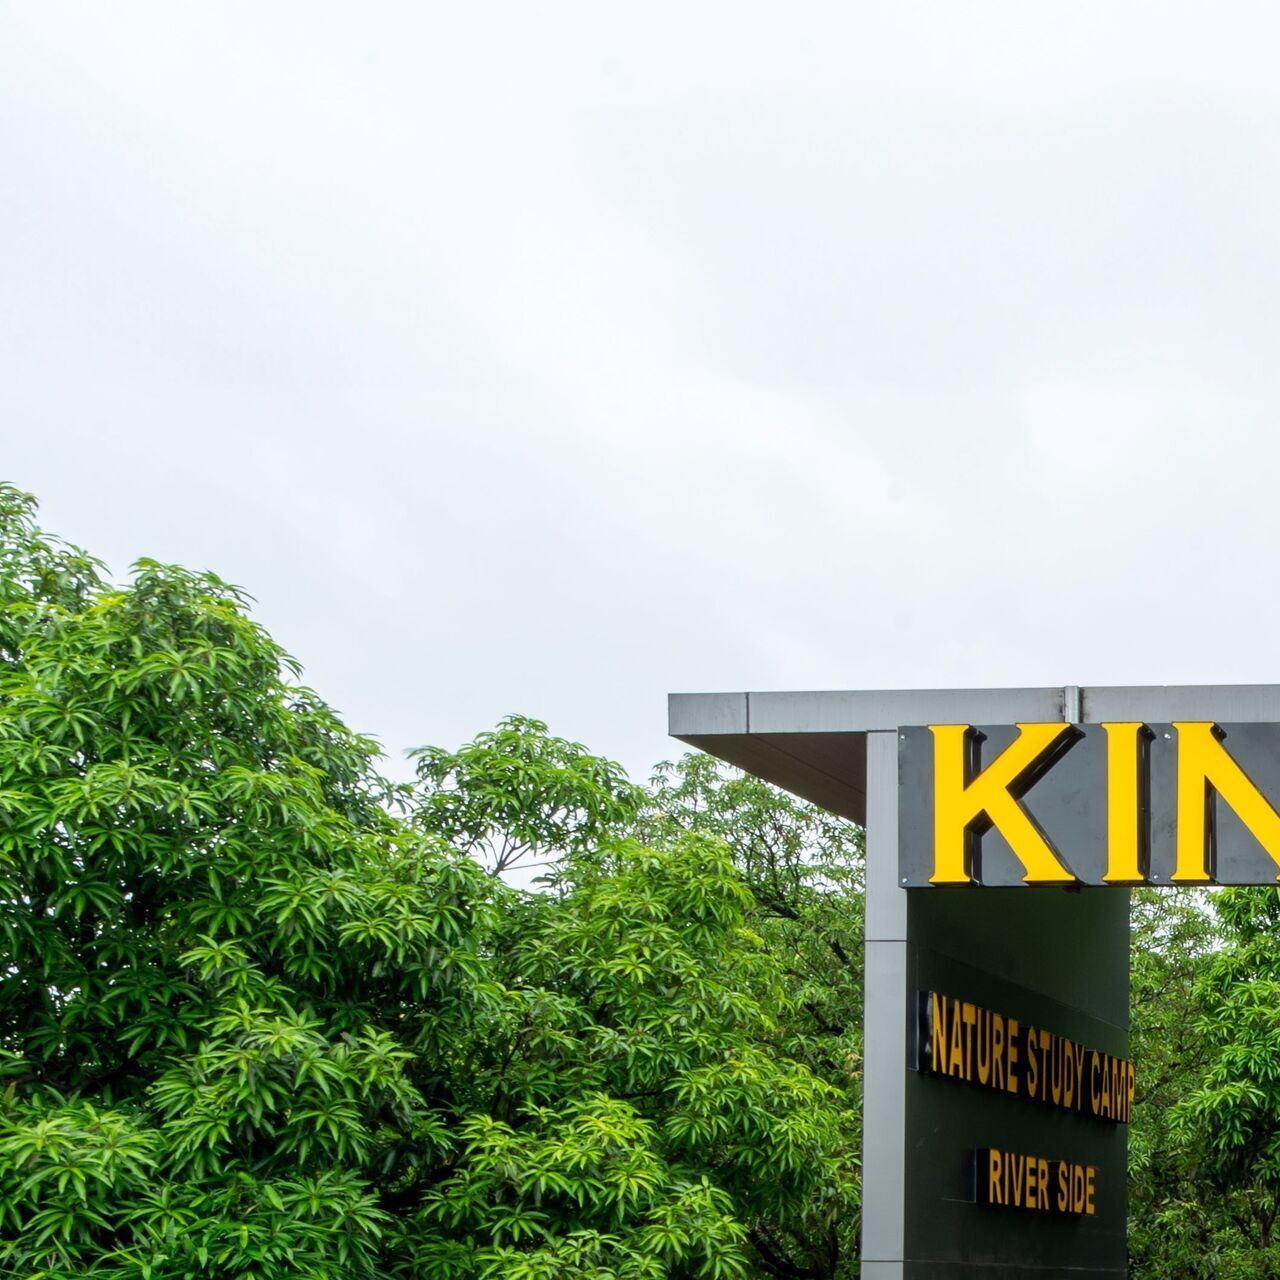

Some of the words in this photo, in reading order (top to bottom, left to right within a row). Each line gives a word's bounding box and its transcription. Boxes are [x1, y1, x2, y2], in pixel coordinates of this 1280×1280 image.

[931, 992, 1018, 1093] NATURE
[1027, 1026, 1085, 1110] STUDY
[1091, 1050, 1135, 1123] CAMP
[989, 1149, 1049, 1210] RIVER
[1057, 1161, 1095, 1215] SIDE
